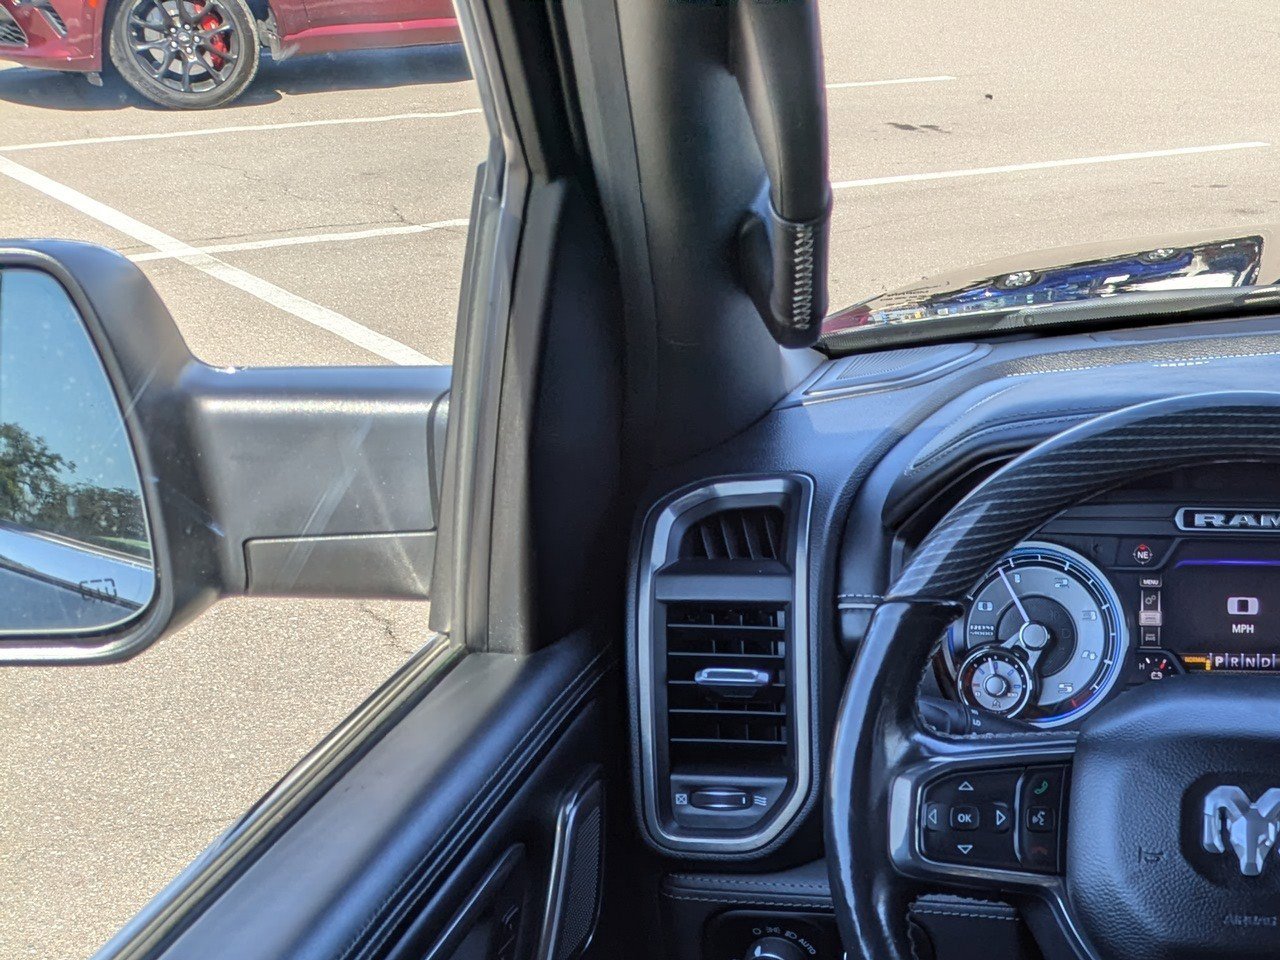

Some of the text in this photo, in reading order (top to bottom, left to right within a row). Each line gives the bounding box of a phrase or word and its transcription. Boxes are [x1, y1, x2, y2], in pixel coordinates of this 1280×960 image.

[1137, 551, 1149, 560] NE
[1227, 597, 1259, 615] 0
[1232, 624, 1254, 634] MPH
[1214, 656, 1271, 668] P R N D
[957, 813, 972, 823] OK
[798, 937, 817, 955] AUTO
